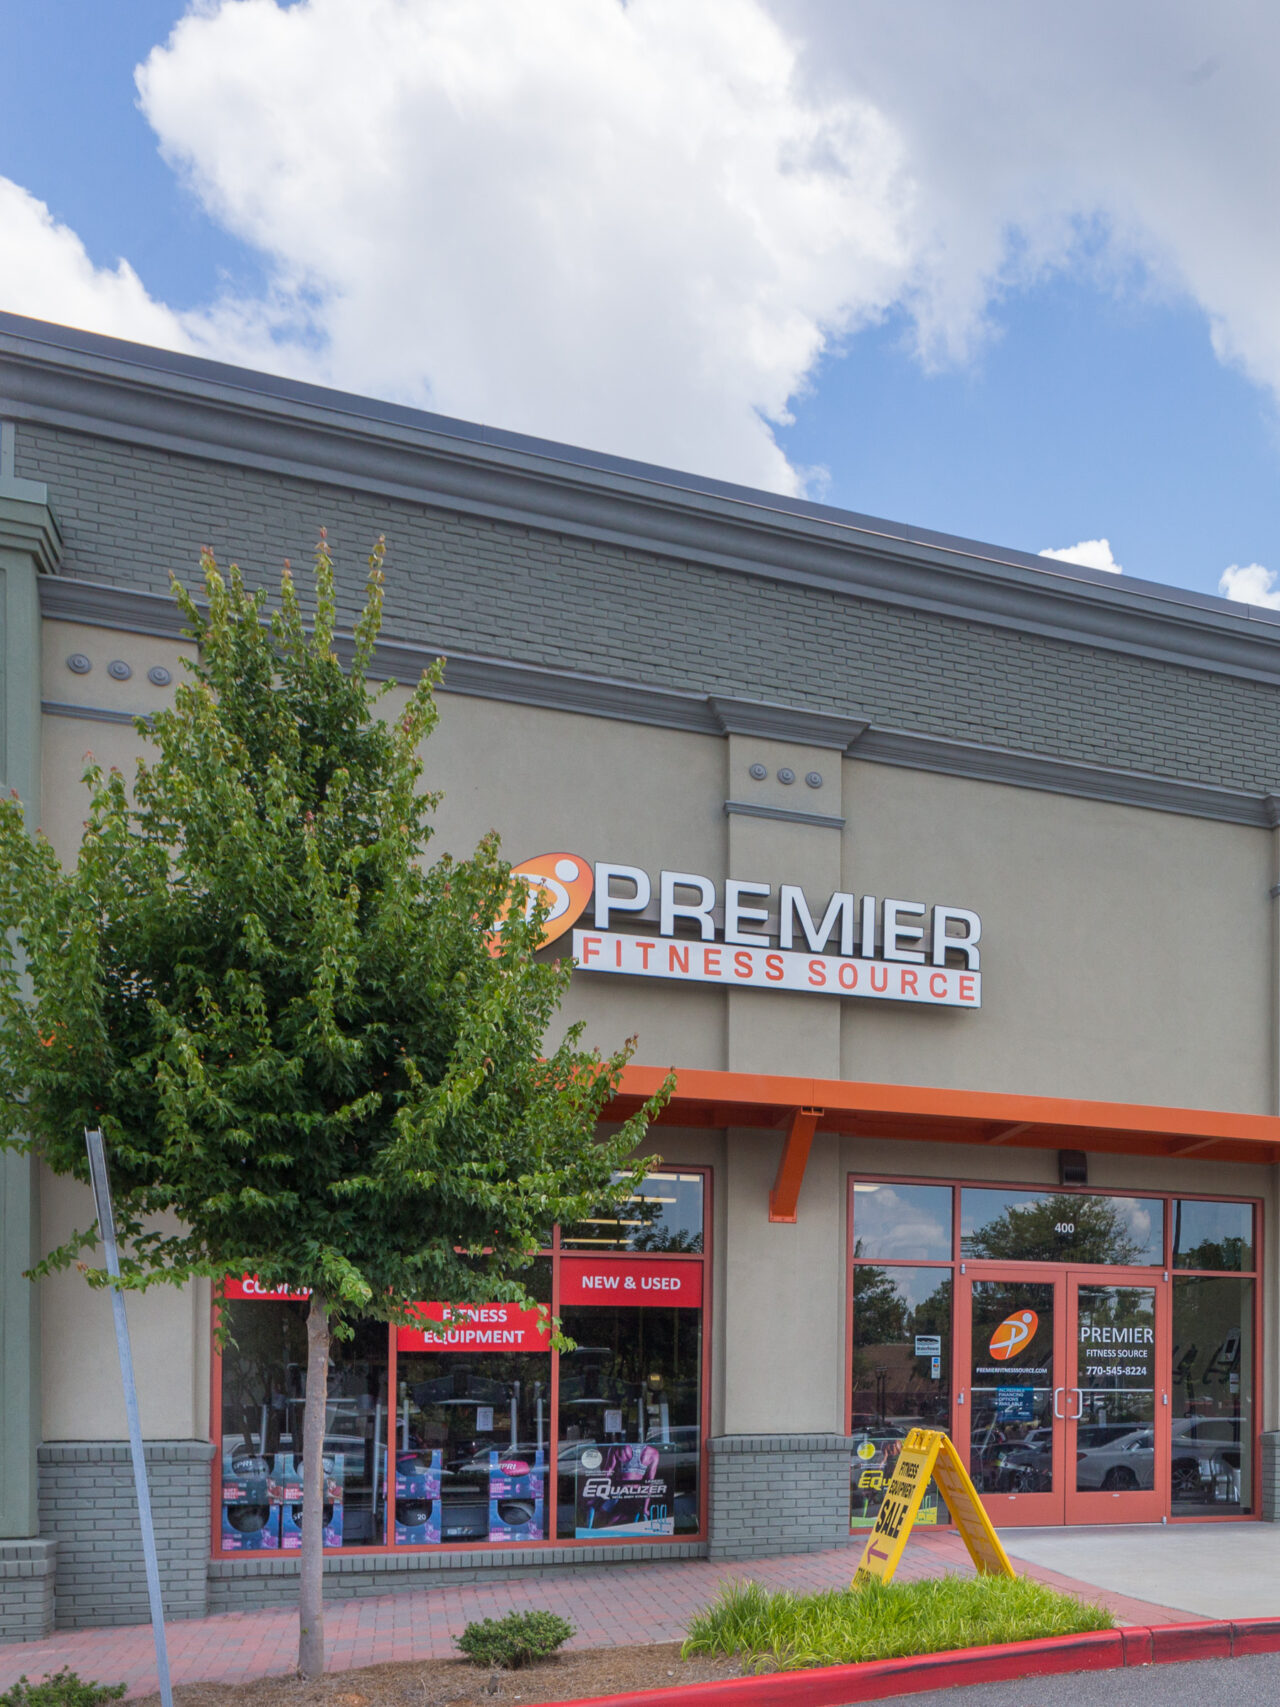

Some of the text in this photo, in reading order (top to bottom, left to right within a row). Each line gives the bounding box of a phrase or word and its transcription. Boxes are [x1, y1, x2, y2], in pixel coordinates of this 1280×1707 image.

[594, 862, 982, 971] PREMIER
[582, 936, 976, 1002] FITNESS SOURCE
[1054, 1222, 1075, 1234] 400
[582, 1275, 681, 1291] NEW & USED
[442, 1308, 508, 1323] FTNESS
[423, 1329, 525, 1345] EQUIPMENT
[1080, 1326, 1154, 1344] PREMIER
[1086, 1349, 1148, 1358] FITNESS SOURCE
[1086, 1366, 1147, 1376] 770-545-8224
[582, 1478, 667, 1500] EQUALIZER
[416, 1513, 427, 1521] 20
[874, 1498, 910, 1539] SALE
